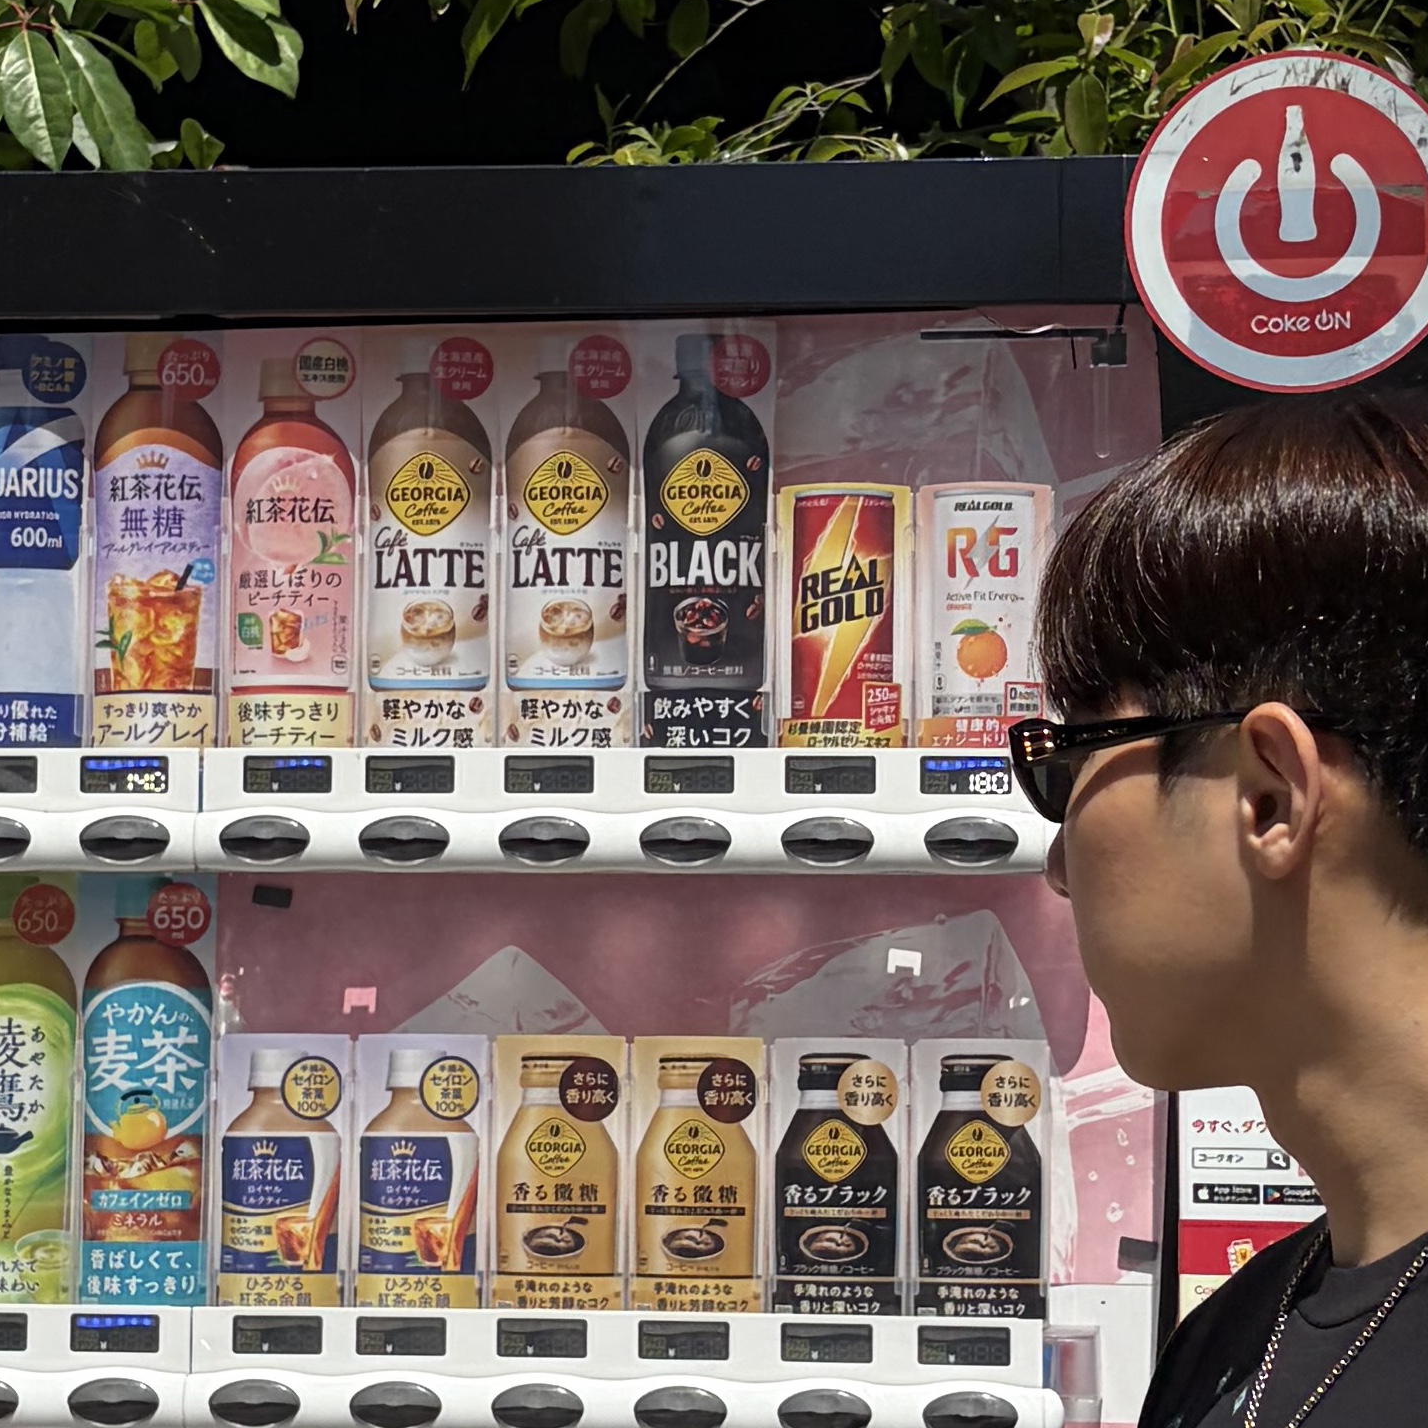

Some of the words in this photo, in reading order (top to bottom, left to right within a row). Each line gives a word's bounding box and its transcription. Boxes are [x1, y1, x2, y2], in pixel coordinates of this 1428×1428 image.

[1250, 313, 1311, 334] Coke
[1314, 308, 1351, 331] ON
[108, 473, 203, 502] 紅茶花伝
[389, 486, 466, 503] GEORGIA
[527, 486, 603, 501] GEORGIA
[666, 484, 742, 501] GEORGIA
[245, 497, 336, 524] 紅茶花伝
[404, 503, 450, 518] Coffee
[542, 502, 588, 517] Coffee
[120, 506, 186, 539] 無糖
[10, 527, 63, 548] 600ml
[946, 526, 1019, 578] RG
[373, 547, 486, 589] LATTE
[511, 547, 623, 588] LATTE
[649, 540, 763, 588] BLACK
[801, 552, 884, 606] REAL
[247, 592, 330, 607] ピーチティー
[800, 586, 884, 635] GOLD
[103, 701, 203, 719] すっきり爽やか
[237, 701, 340, 723] 後味すっきり
[382, 698, 466, 721] 軽やかな
[520, 698, 604, 720] 軽やかな
[654, 698, 751, 720] 飲みやすく
[98, 721, 209, 745] アールグレイ
[241, 727, 336, 745] ピーチティー
[665, 726, 752, 748] 深いコク
[968, 772, 1009, 794] 180
[28, 1025, 46, 1114] あやたか
[87, 1025, 205, 1095] 麦茶
[291, 1073, 335, 1087] セイロン
[429, 1074, 473, 1088] セイロン
[572, 1072, 609, 1086] さらに
[710, 1074, 748, 1088] さらに
[851, 1074, 887, 1087] さらに
[994, 1076, 1030, 1088] さらに
[565, 1088, 615, 1105] 香り高く
[704, 1090, 754, 1107] 香り高く
[844, 1091, 894, 1107] 香り高く
[986, 1092, 1036, 1108] 香り高く
[529, 1141, 582, 1154] GEORGIA
[668, 1143, 720, 1156] GEORGIA
[807, 1144, 862, 1157] GEORGIA
[950, 1146, 1004, 1158] GEORGIA
[232, 1158, 305, 1182] 紅茶花伝
[370, 1159, 443, 1183] 紅茶花伝
[512, 1182, 599, 1203] 香る微糖
[650, 1184, 738, 1205] 香る微糖
[783, 1184, 888, 1204] 香るブラック
[926, 1186, 1030, 1206] 香るブラック
[1213, 1185, 1229, 1196] App
[1232, 1185, 1253, 1195] Store
[1283, 1187, 1311, 1199] Google
[90, 1249, 194, 1270] 香ばしくて、
[87, 1274, 198, 1295] 後味すっきり
[246, 1276, 304, 1291] ひろがる
[384, 1277, 442, 1292] ひろがる
